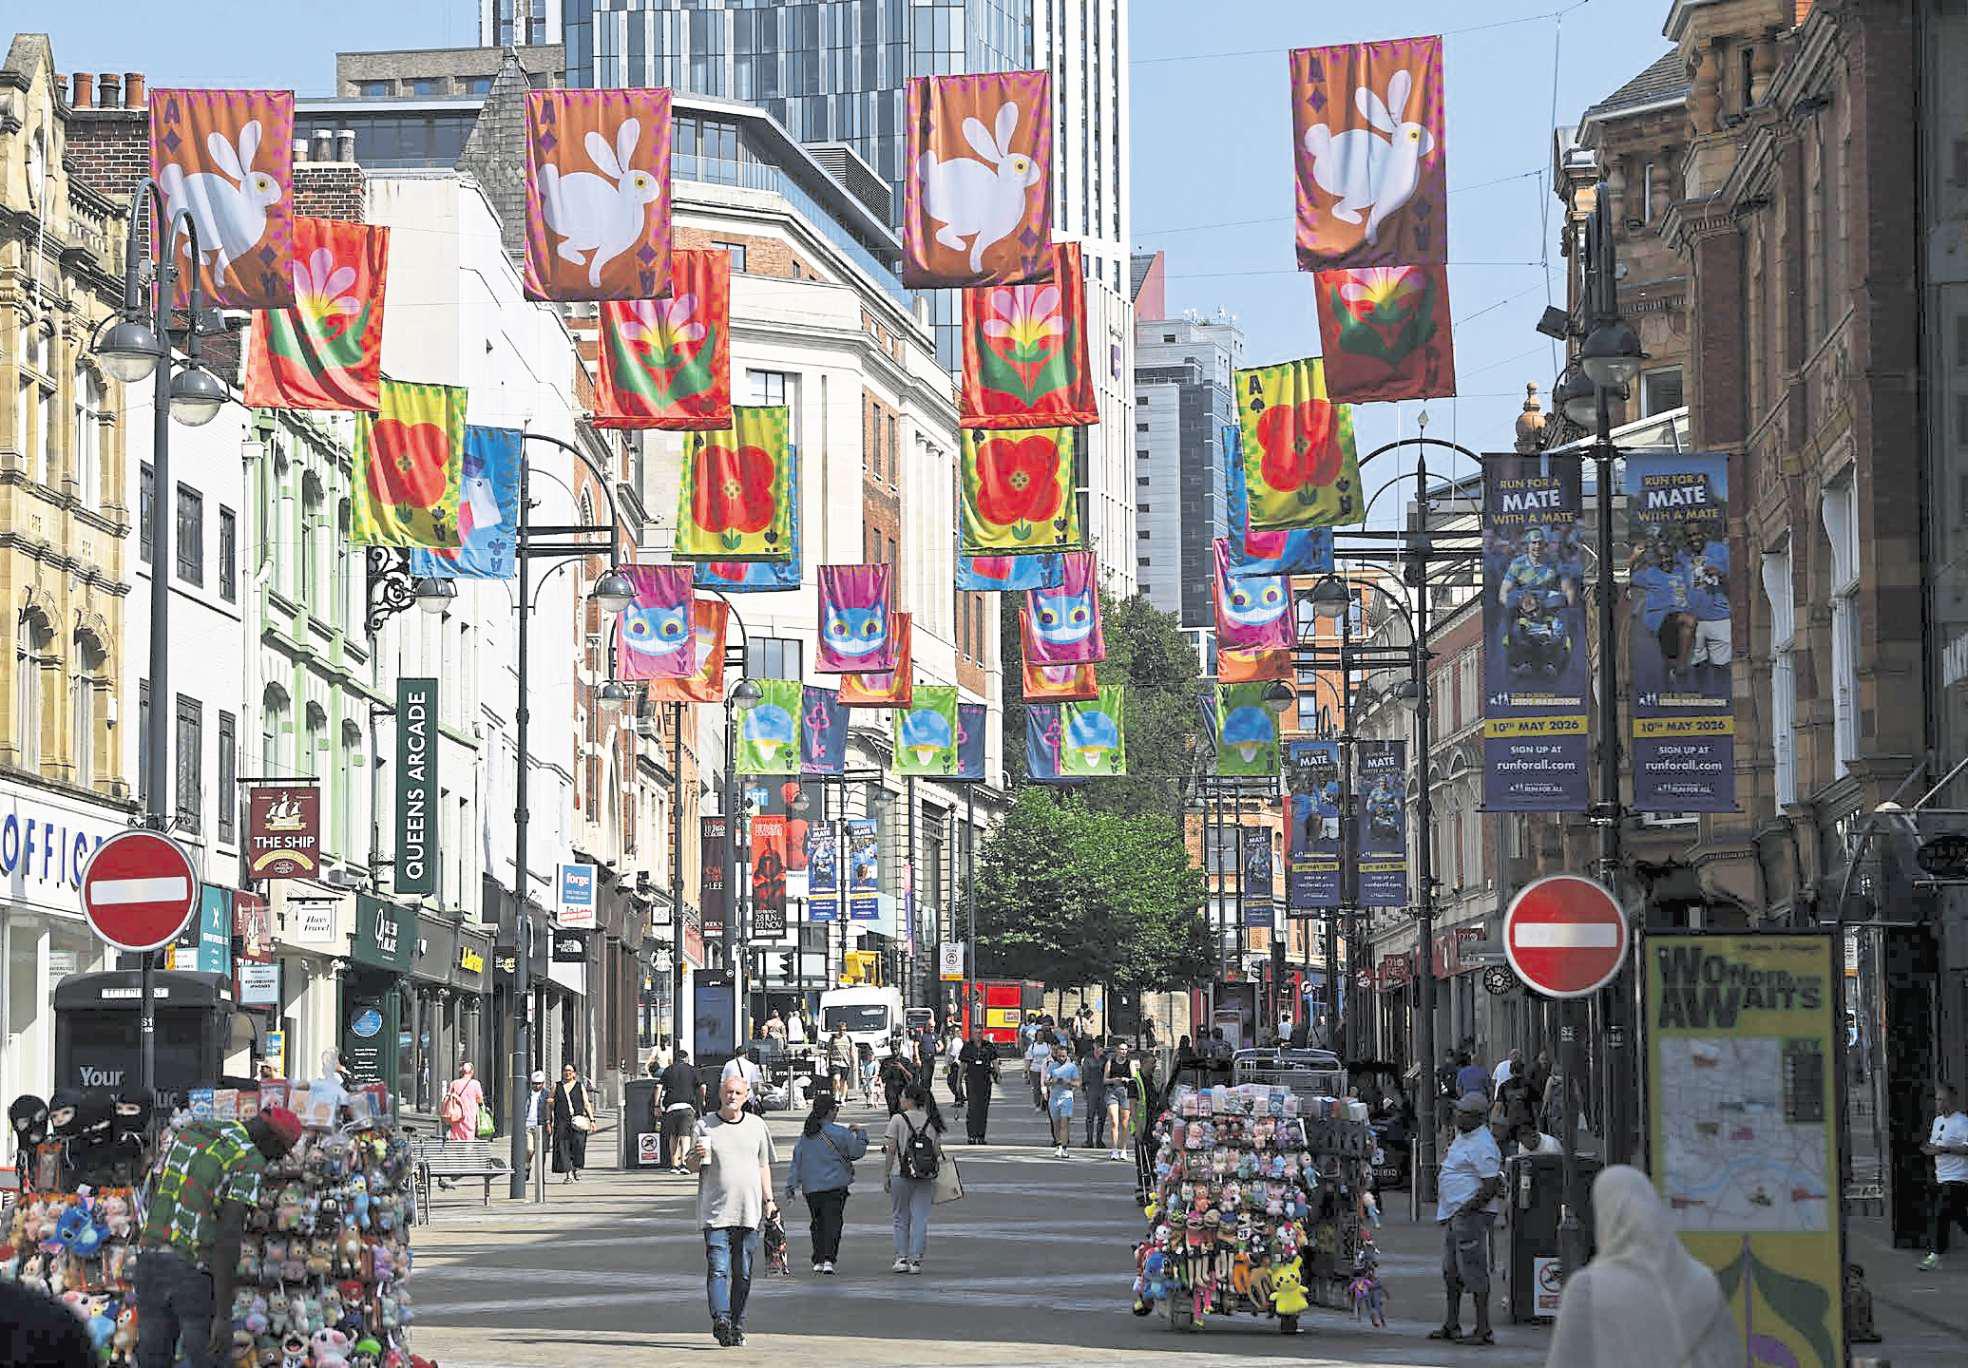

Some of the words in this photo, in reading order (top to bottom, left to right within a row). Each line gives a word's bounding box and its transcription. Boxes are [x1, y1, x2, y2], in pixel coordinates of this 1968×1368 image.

[164, 98, 180, 124] A
[541, 99, 555, 124] A
[1248, 374, 1262, 395] A
[1500, 479, 1524, 489] RUN
[1527, 479, 1549, 488] FOR
[1552, 479, 1561, 487] A
[1645, 475, 1668, 486] RUN
[1671, 475, 1694, 485] FOR
[1696, 474, 1706, 484] A
[1503, 490, 1561, 512] MATE
[1648, 486, 1706, 509] MATE
[1492, 513, 1523, 524] WITH
[1528, 514, 1537, 523] A
[1541, 512, 1574, 523] MATE
[1638, 511, 1669, 522] WITH
[1674, 511, 1683, 520] A
[1686, 509, 1719, 519] MATE
[1492, 723, 1515, 732] 10TH
[1519, 722, 1545, 731] MAY
[1550, 721, 1579, 730] 2026
[1641, 722, 1663, 732] 10TH
[1667, 722, 1693, 730] MAY
[1696, 721, 1725, 730] 2026
[406, 691, 425, 782] ARCADE
[1510, 746, 1533, 754] SIGN
[1658, 746, 1681, 754] SIGN
[1684, 746, 1696, 754] UP
[1300, 756, 1327, 767] MATE
[1368, 758, 1395, 767] MATE
[1497, 760, 1575, 771] runforall.com
[1645, 760, 1722, 771] runforall.com
[406, 788, 424, 880] QUEENS
[254, 837, 281, 848] THE
[285, 837, 315, 848] SHIP
[3, 814, 103, 886] OFFIC
[566, 873, 589, 886] forge
[304, 924, 330, 932] Travel
[1658, 987, 1822, 1028] AWAITS
[142, 1018, 153, 1026] S1
[80, 1066, 125, 1087] Your
